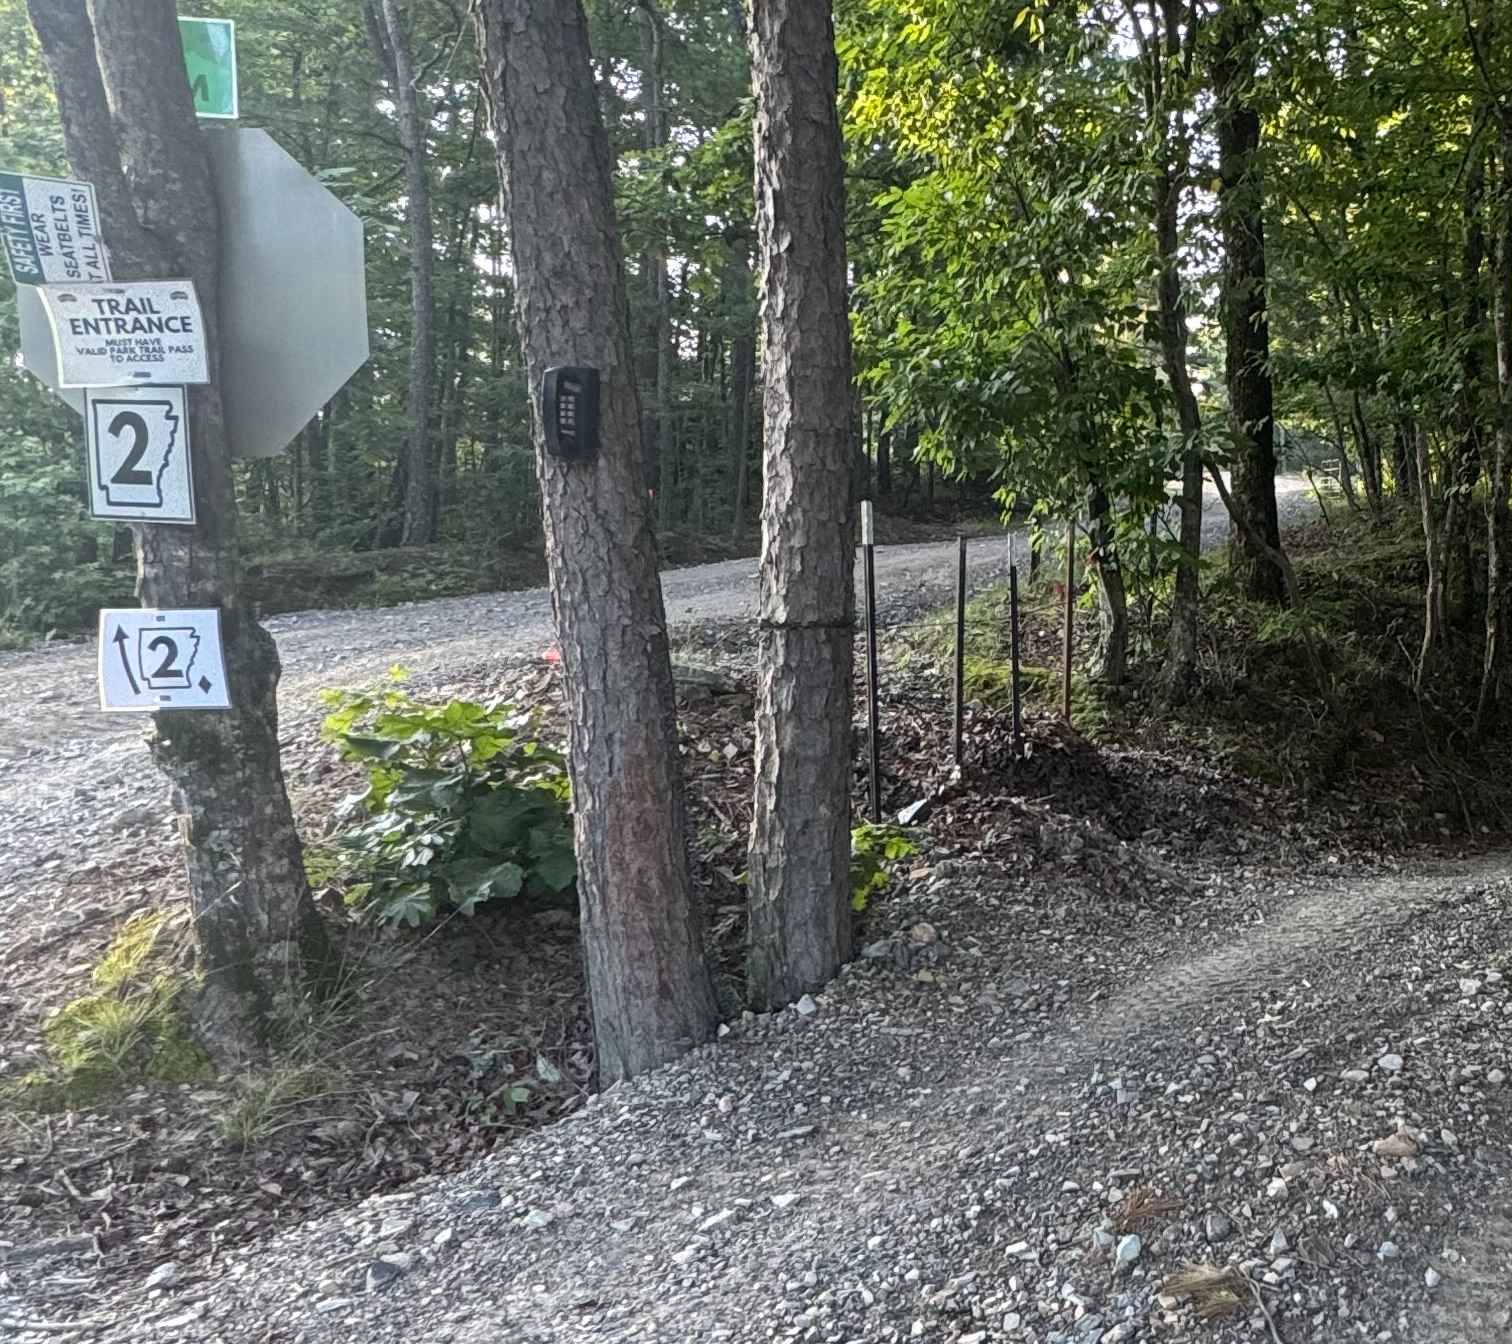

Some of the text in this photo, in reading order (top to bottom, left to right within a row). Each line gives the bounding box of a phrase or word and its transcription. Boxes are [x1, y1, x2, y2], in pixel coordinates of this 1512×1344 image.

[71, 188, 92, 238] TIMES!
[2, 224, 39, 274] SAFETY
[31, 212, 54, 256] WEAR
[50, 195, 81, 278] SEATBELTS
[81, 242, 101, 270] ALL
[92, 297, 161, 316] TRAIL
[69, 316, 193, 336] ENTRANCE
[105, 337, 162, 347] MUST HAVE
[76, 345, 194, 355] VALID PARK TRAIL PASS
[110, 354, 165, 363] TO ACCESS
[108, 411, 153, 485] 2
[148, 635, 184, 679] 2
